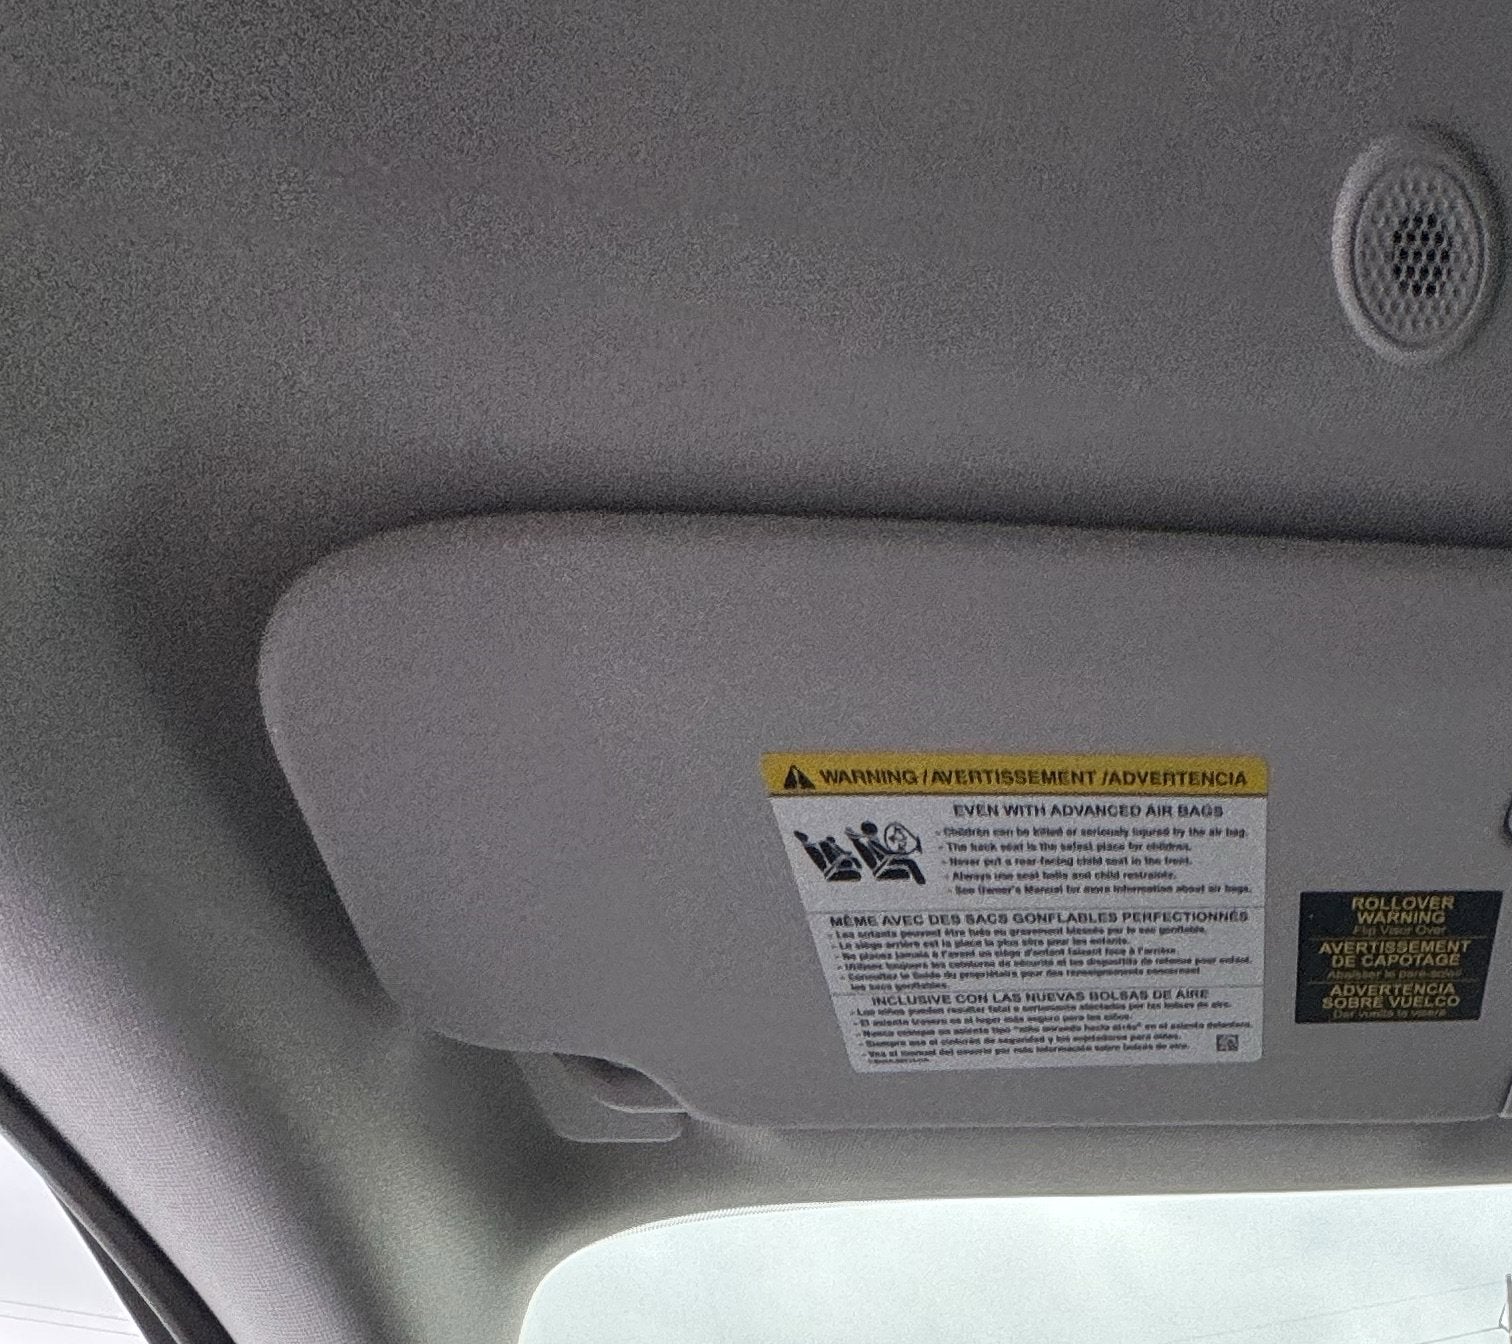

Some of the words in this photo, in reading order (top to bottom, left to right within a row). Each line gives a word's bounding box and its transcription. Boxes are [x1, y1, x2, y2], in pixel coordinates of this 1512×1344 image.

[819, 767, 918, 786] WARNING
[931, 768, 1096, 786] AVERTISSEMENT
[953, 804, 999, 817] EVEN
[1003, 804, 1046, 817] WITH
[1050, 804, 1141, 817] ADVANCED
[1145, 804, 1172, 818] AIR
[1177, 804, 1223, 818] BAGS
[1351, 896, 1455, 910] ROLLOVER
[829, 913, 878, 927] MÊME
[882, 914, 924, 926] AVEC
[928, 914, 960, 926] DES
[965, 913, 1008, 925] SACS
[1012, 912, 1117, 924] GONFLABLES
[1357, 911, 1446, 924] WARNING
[1318, 940, 1471, 954] AVERTISSEMENT
[1332, 955, 1357, 968] DE
[1361, 953, 1461, 967] CAPOTAGE
[1330, 983, 1456, 997] ADVERTENCIA
[871, 994, 950, 1006] INCLUSIVE
[955, 993, 988, 1004] CON
[993, 992, 1021, 1003] LAS
[1026, 991, 1085, 1003] NUEVAS
[1089, 990, 1148, 1001] BOLSAS
[1152, 990, 1171, 1000] DE
[1176, 989, 1209, 999] AIRE
[1321, 996, 1383, 1009] SOBRE
[1388, 995, 1461, 1008] VUELCO
